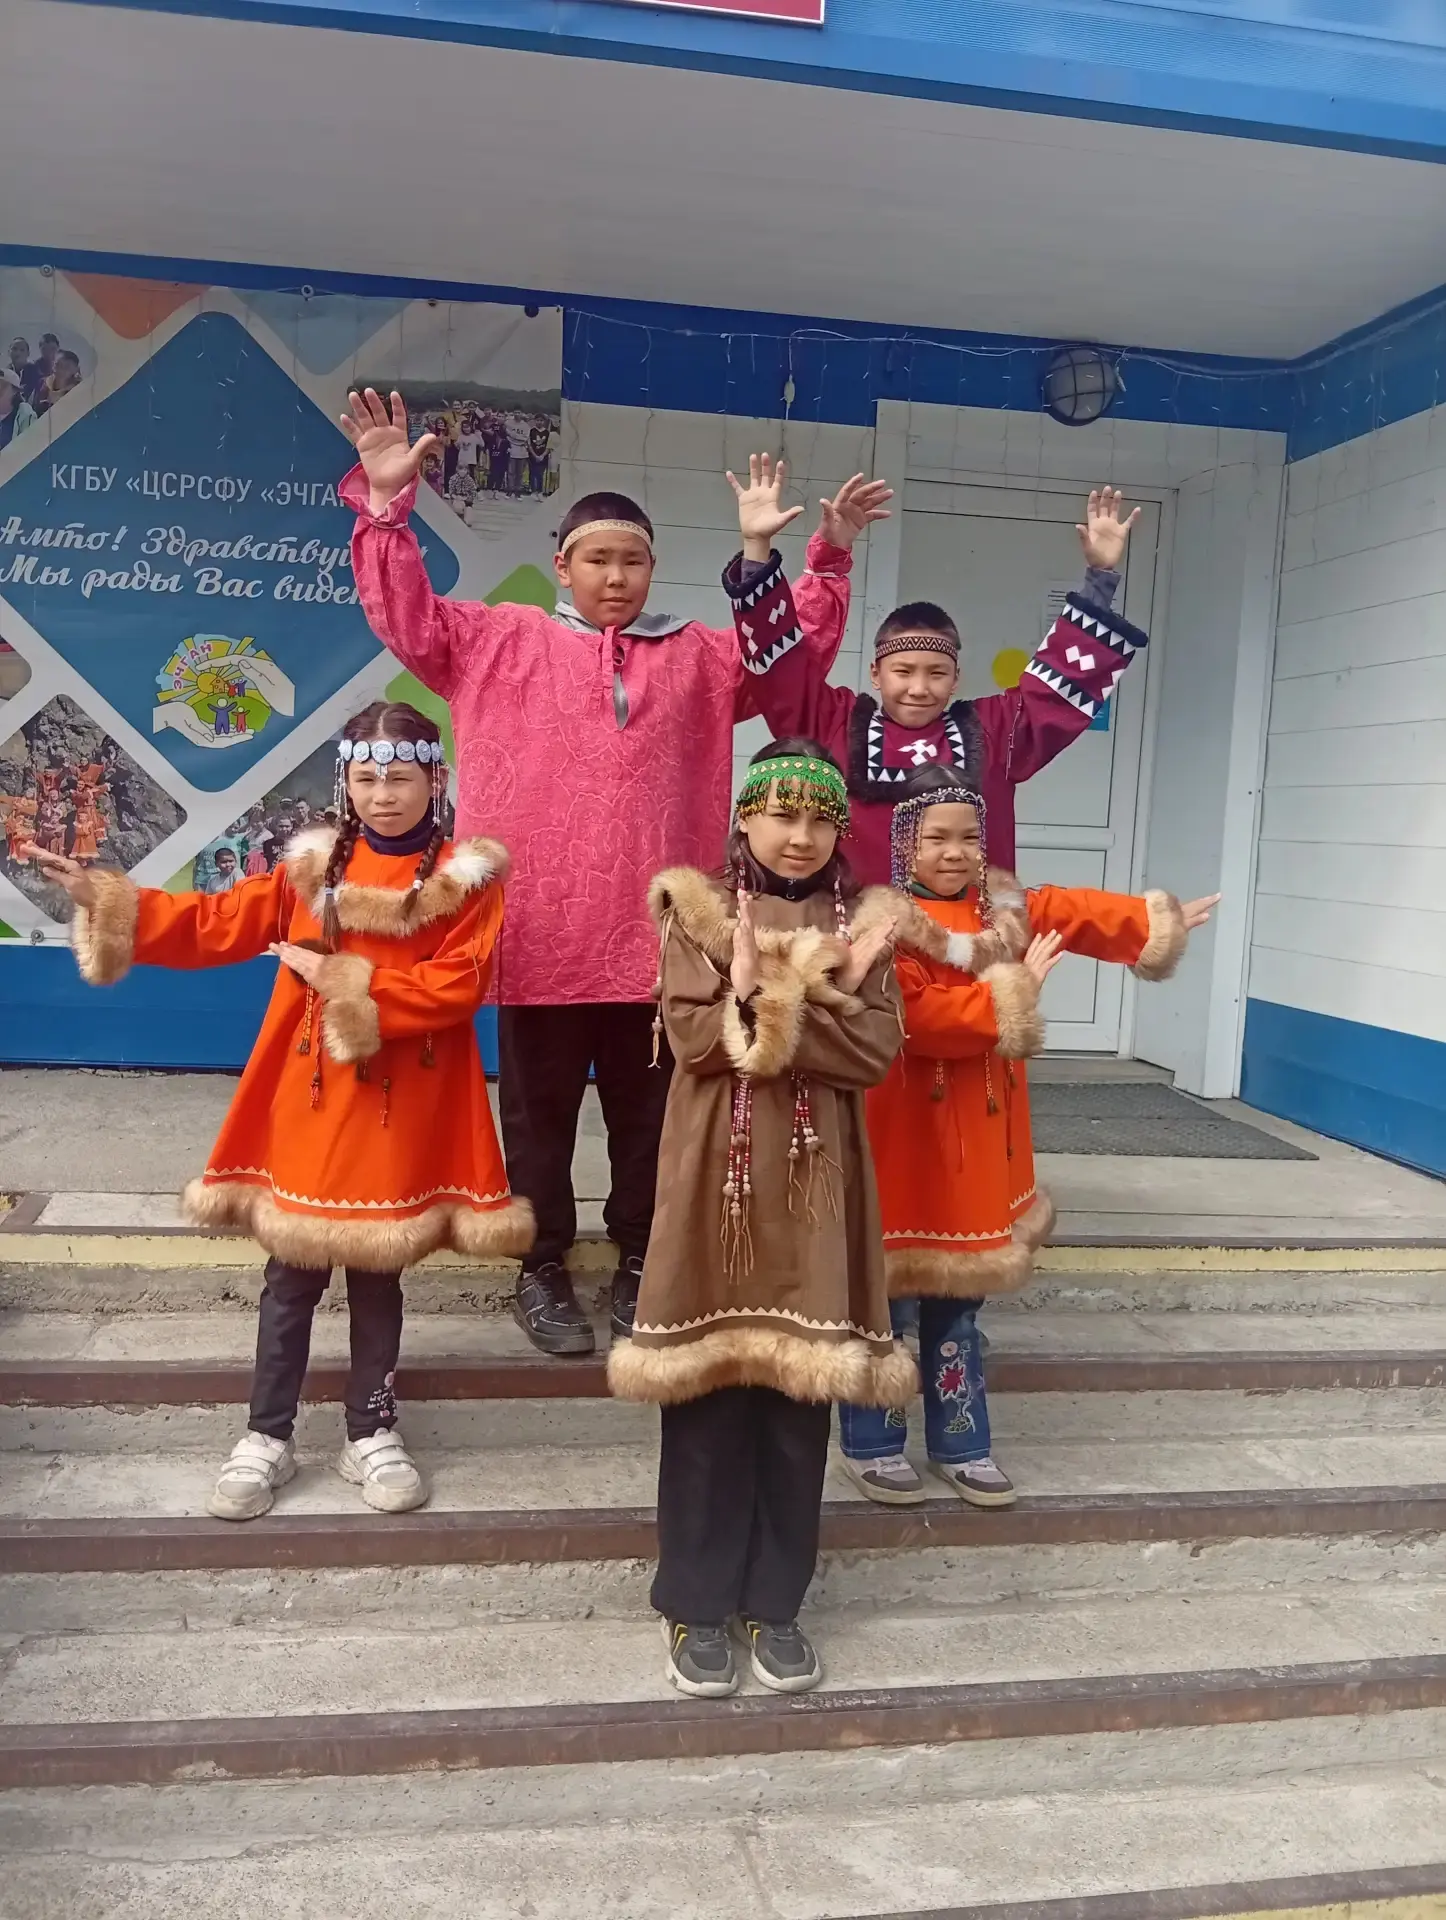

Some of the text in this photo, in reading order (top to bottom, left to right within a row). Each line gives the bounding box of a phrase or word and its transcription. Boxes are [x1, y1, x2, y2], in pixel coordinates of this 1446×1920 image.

[51, 463, 345, 508] КГБУ «ЦСРСФУ «ЭЧГА
[0, 516, 128, 551] Амто!
[0, 554, 363, 605] Мы рады Вас виде
